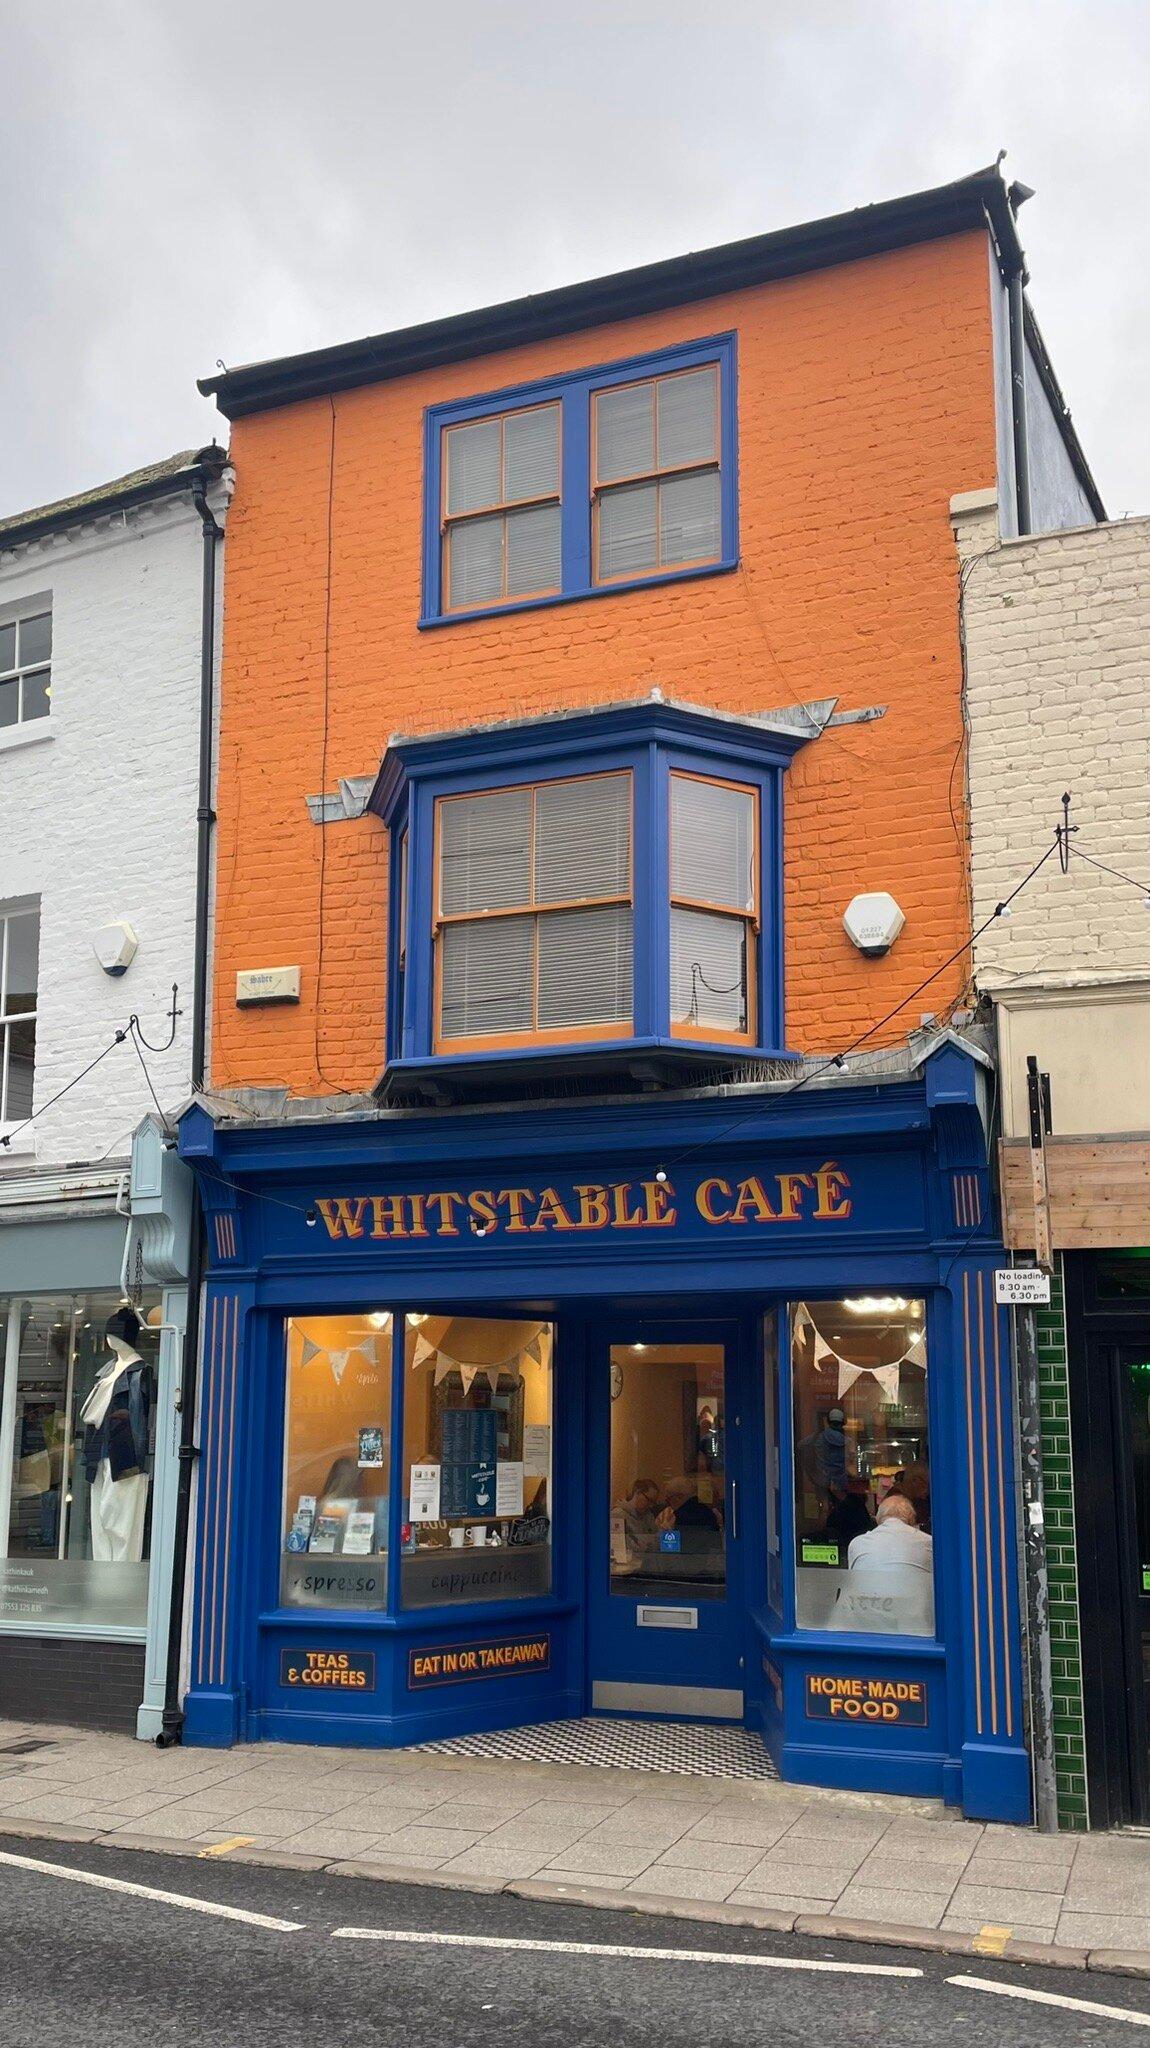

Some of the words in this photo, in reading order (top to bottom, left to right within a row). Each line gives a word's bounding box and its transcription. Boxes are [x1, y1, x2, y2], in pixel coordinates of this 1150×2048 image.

[315, 1179, 677, 1239] WHITSTABLE
[695, 1160, 851, 1224] CAFÉ
[294, 1576, 376, 1594] spresso
[306, 1652, 349, 1669] TEAS
[414, 1656, 441, 1677] EAT
[442, 1654, 459, 1673] IN
[459, 1651, 479, 1670] OR
[479, 1641, 548, 1668] TAKEAWAY
[288, 1667, 300, 1683] &
[301, 1668, 367, 1686] COFFEES
[810, 1677, 921, 1702] HOME-MADE
[830, 1698, 900, 1719] FOOD
